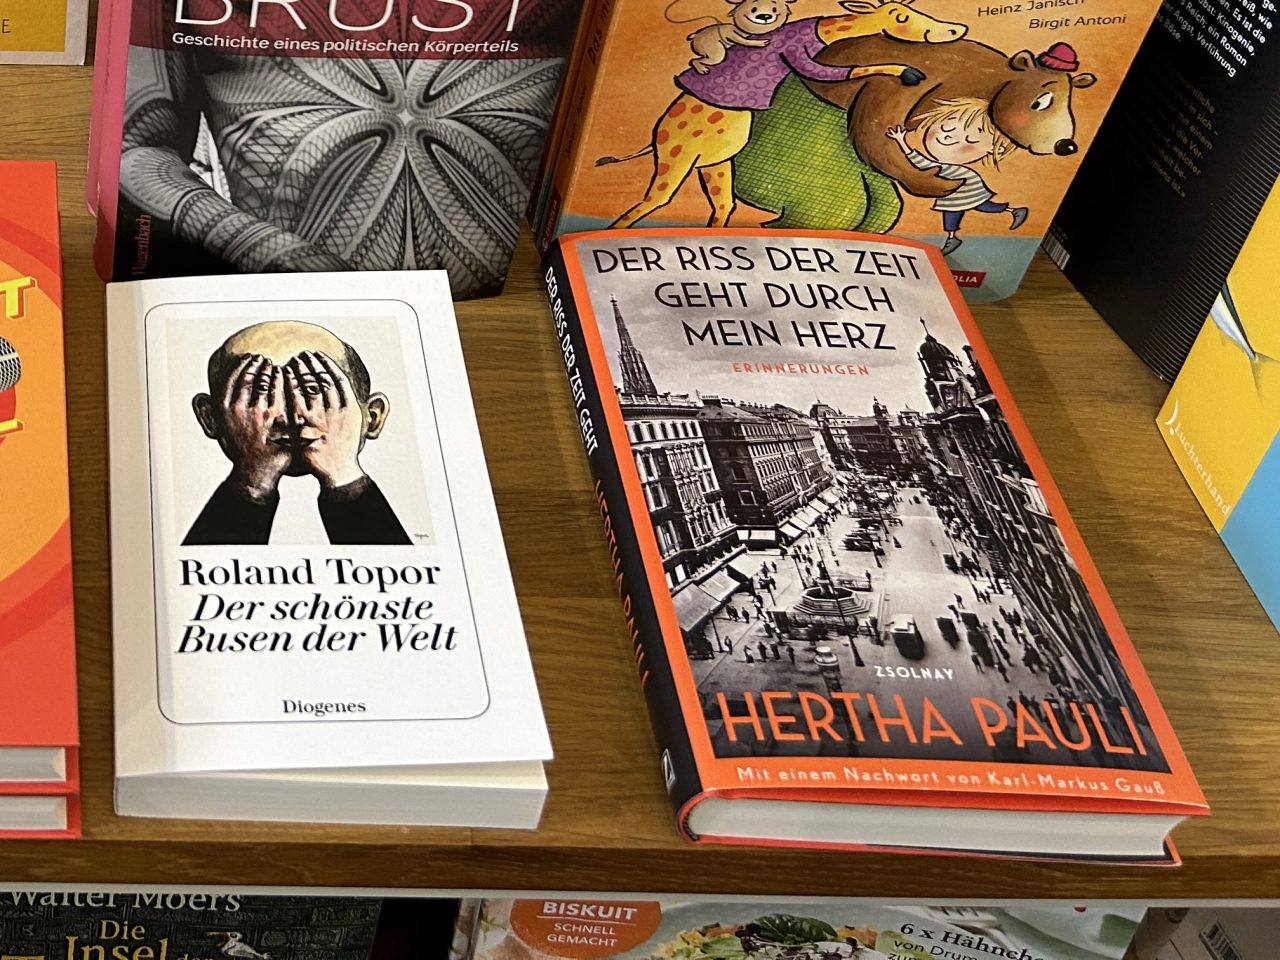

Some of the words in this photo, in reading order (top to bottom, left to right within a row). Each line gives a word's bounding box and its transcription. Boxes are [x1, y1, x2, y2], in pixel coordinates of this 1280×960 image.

[977, 1, 1023, 18] Heinz
[1028, 15, 1071, 32] Birgit
[1074, 13, 1128, 28] Antoni
[172, 31, 270, 50] Geschichte
[273, 36, 320, 52] eines
[323, 37, 420, 54] politischen
[424, 37, 519, 56] Körperteils
[1216, 12, 1255, 57] Kinogenie,
[1196, 32, 1237, 78] Verführung
[1220, 36, 1248, 67] Roman
[593, 247, 665, 274] DER
[676, 245, 755, 272] RISS
[766, 247, 838, 274] DER
[846, 249, 920, 280] ZEIT
[654, 282, 748, 309] GEHT
[763, 282, 896, 313] DURCH
[681, 319, 781, 348] MEIN
[792, 320, 897, 351] HERZ
[732, 361, 870, 377] ERINNERUNGEN
[1173, 422, 1232, 518] Luchterhand
[178, 558, 316, 586] Roland
[325, 558, 441, 593] Topor
[190, 593, 265, 621] Der
[270, 593, 434, 621] schönste
[174, 624, 293, 654] Busen
[302, 623, 367, 652] der
[377, 623, 459, 653] Welt
[875, 665, 955, 681] ZSOLNAY
[282, 699, 367, 716] Diogenes
[717, 691, 964, 747] HERTHA
[970, 696, 1147, 756] PAULI
[737, 766, 772, 782] Mit
[779, 766, 836, 783] einem
[844, 765, 938, 786] Nachwort
[947, 772, 981, 787] von
[988, 771, 1109, 793] Karl-Markus
[1114, 777, 1166, 796] Gauß
[542, 901, 638, 921] BISKUIT
[99, 920, 146, 940] Die
[547, 933, 619, 947] GEMACHT
[554, 922, 617, 936] SCHNELL
[900, 923, 916, 936] 6
[919, 929, 935, 940] x
[893, 939, 926, 953] von
